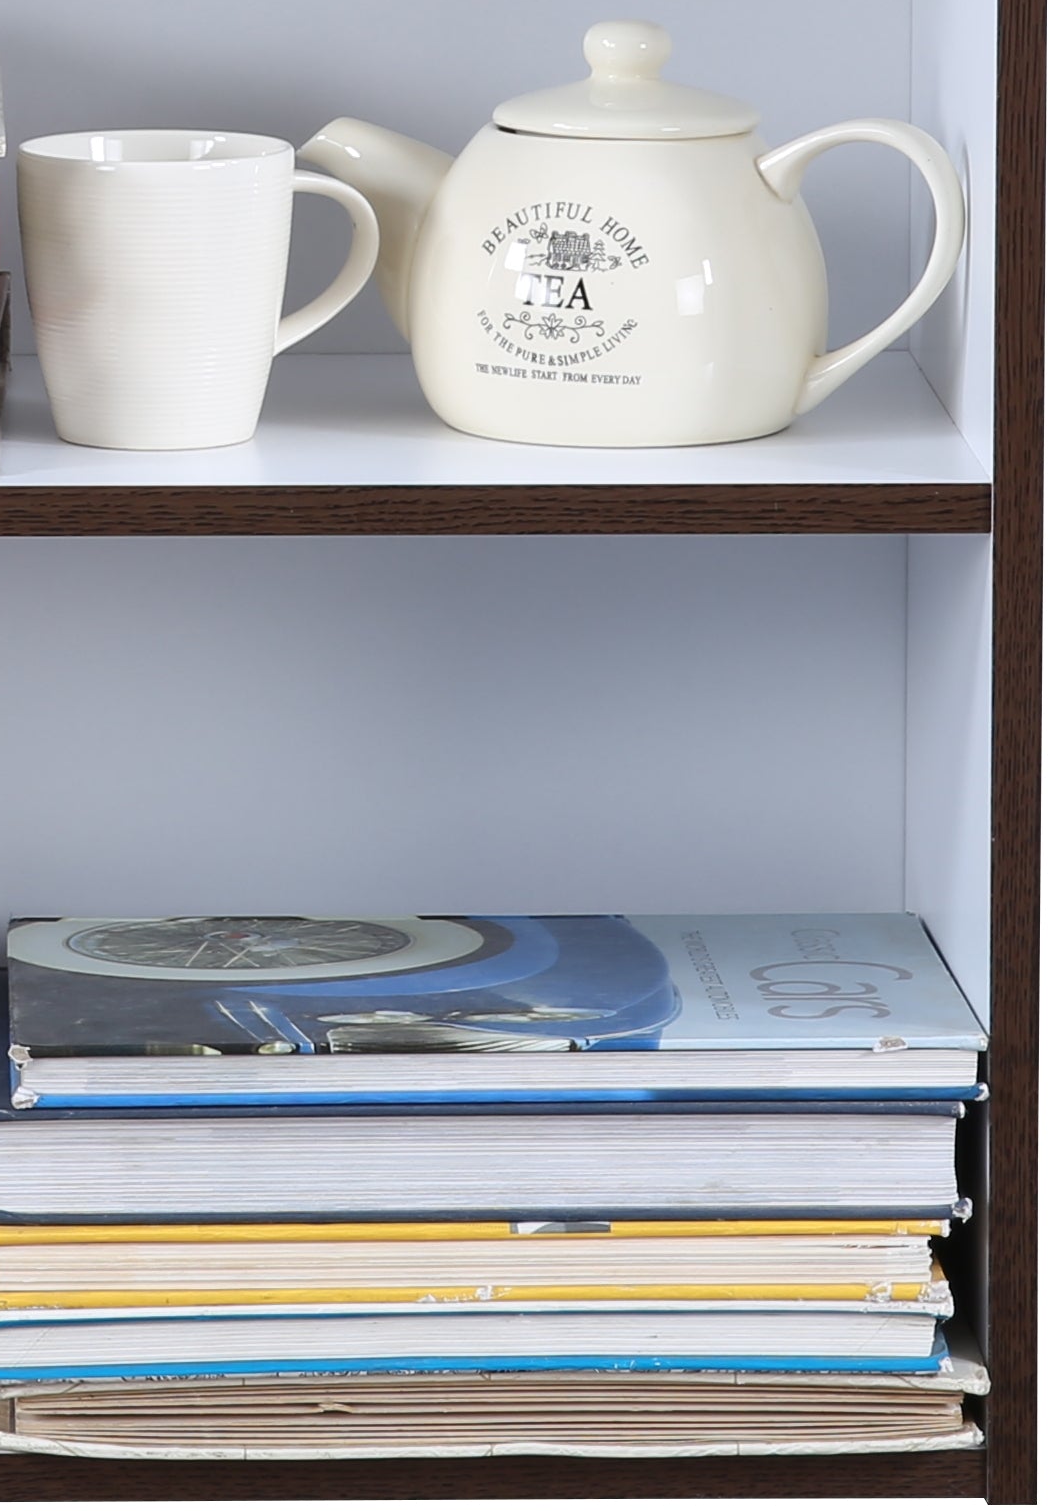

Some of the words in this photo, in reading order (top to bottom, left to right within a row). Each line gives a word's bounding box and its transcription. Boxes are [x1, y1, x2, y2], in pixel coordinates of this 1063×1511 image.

[480, 201, 594, 256] BEAUTIFUL
[599, 216, 650, 270] HOME
[520, 272, 594, 311] TEA
[477, 309, 493, 334] FOR
[493, 331, 515, 354] THE
[515, 346, 546, 365] PURE
[602, 318, 639, 353] LIVING
[475, 362, 489, 374] THE
[531, 369, 558, 381] START
[562, 372, 588, 383] FROM
[749, 959, 914, 1021] Cars
